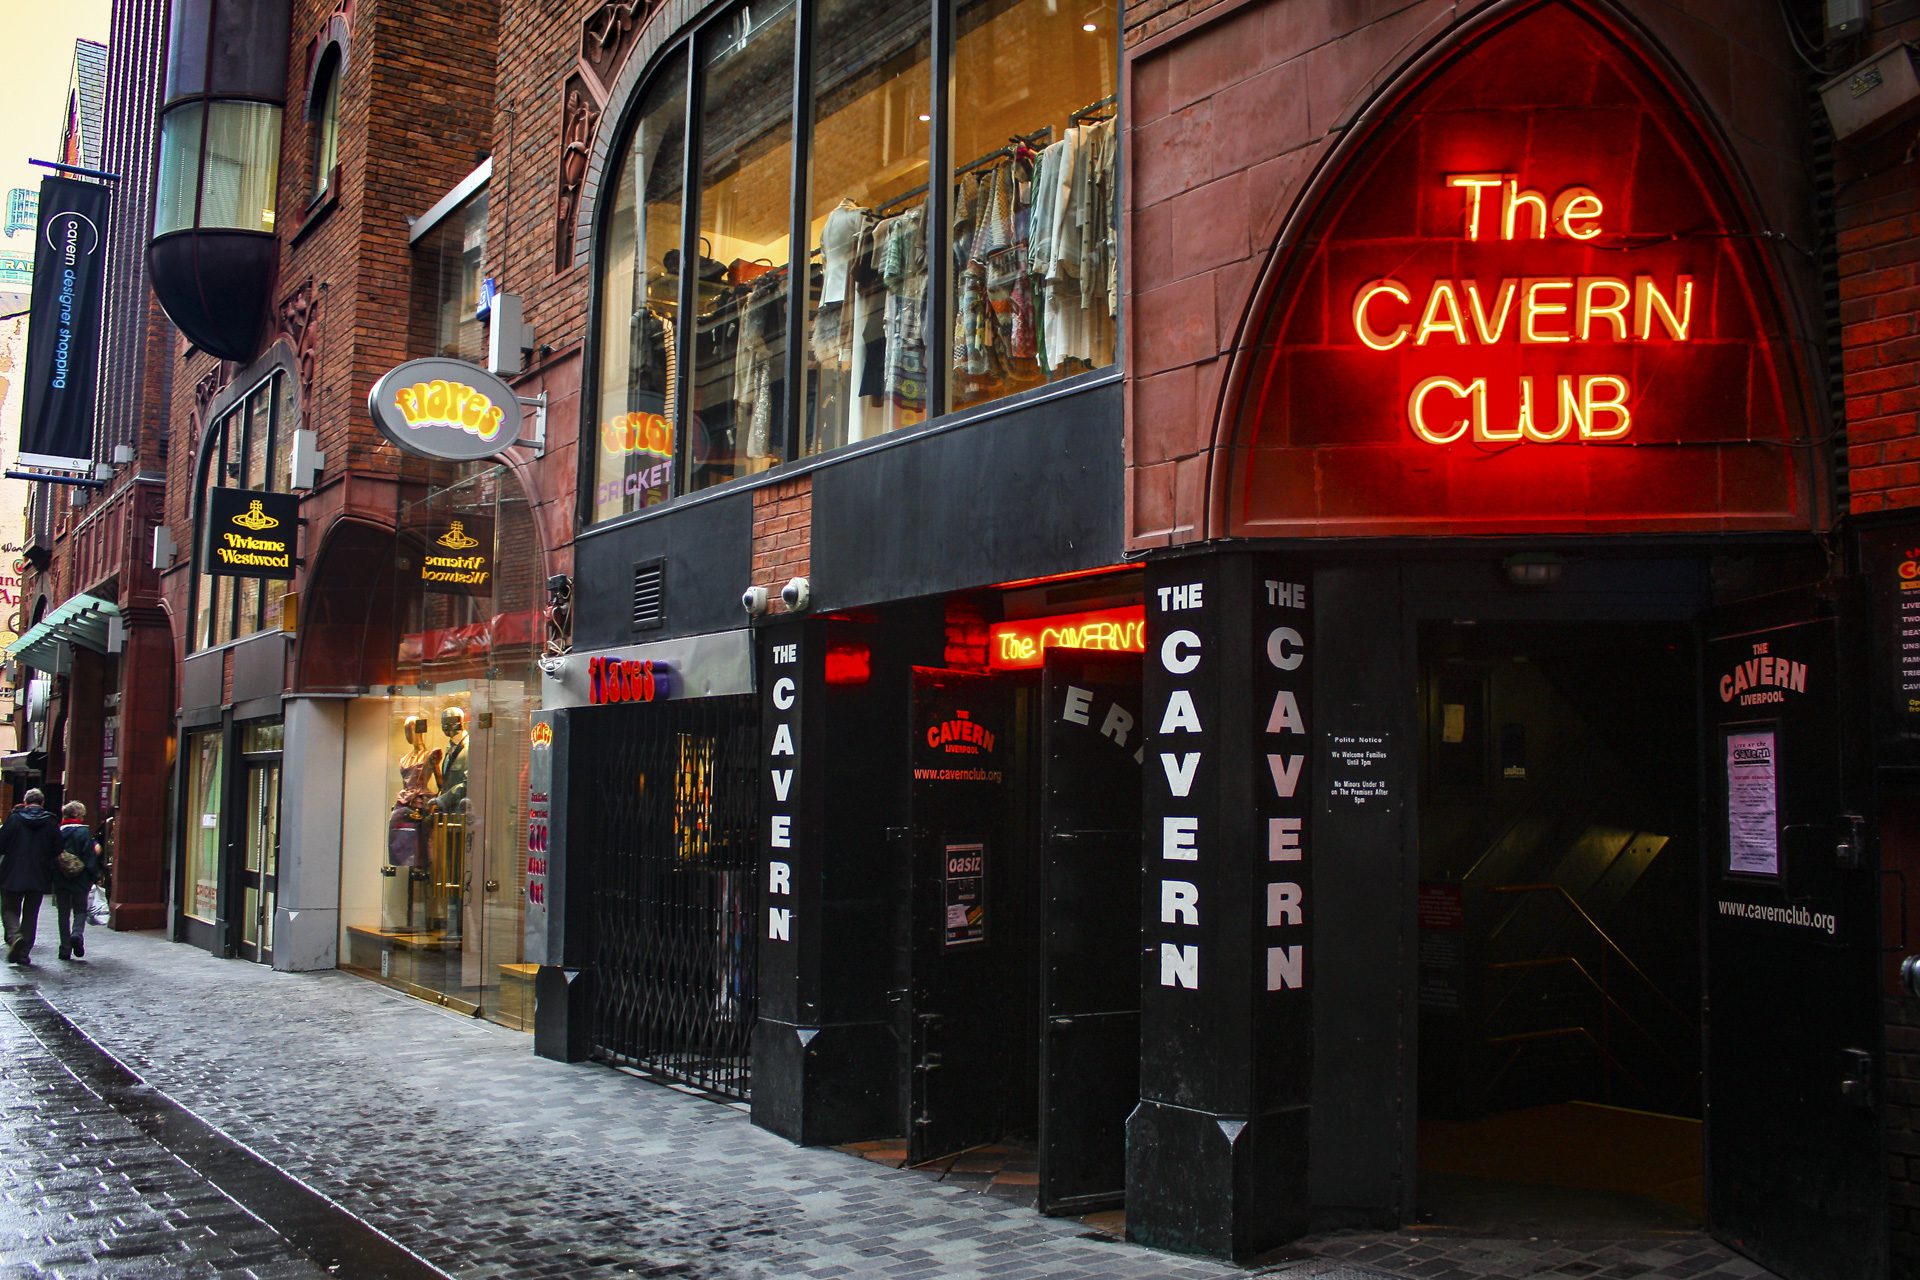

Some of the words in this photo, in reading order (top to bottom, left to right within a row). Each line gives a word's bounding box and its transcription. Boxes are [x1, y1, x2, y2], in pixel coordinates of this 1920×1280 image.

[1447, 173, 1604, 241] The
[66, 220, 79, 266] cavern
[59, 269, 76, 326] designer
[1352, 275, 1693, 350] CAVERN
[52, 328, 70, 389] shopping
[394, 379, 507, 442] flares
[1408, 374, 1631, 445] CLUB
[217, 547, 289, 568] Westwood
[223, 532, 286, 552] Vivienne
[1157, 583, 1203, 611] THE
[1265, 580, 1306, 609] THE
[773, 643, 797, 664] THE
[998, 633, 1037, 659] The
[1752, 643, 1769, 655] THE
[588, 656, 655, 705] flares
[1719, 656, 1808, 703] CAVERN
[1740, 690, 1784, 706] LIVERPOOL
[927, 719, 996, 754] CAVERN
[945, 744, 980, 755] LIVERPOOL
[914, 766, 1002, 784] www.cavernclub.org
[1339, 788, 1349, 796] The
[1350, 788, 1374, 796] Premises
[1375, 788, 1389, 796] After
[769, 677, 796, 942] CAVERN
[1159, 629, 1203, 990] CAVERN
[1266, 626, 1305, 991] CAVERN
[949, 852, 982, 873] oasiz
[1718, 900, 1836, 934] www.cavernclub.org
